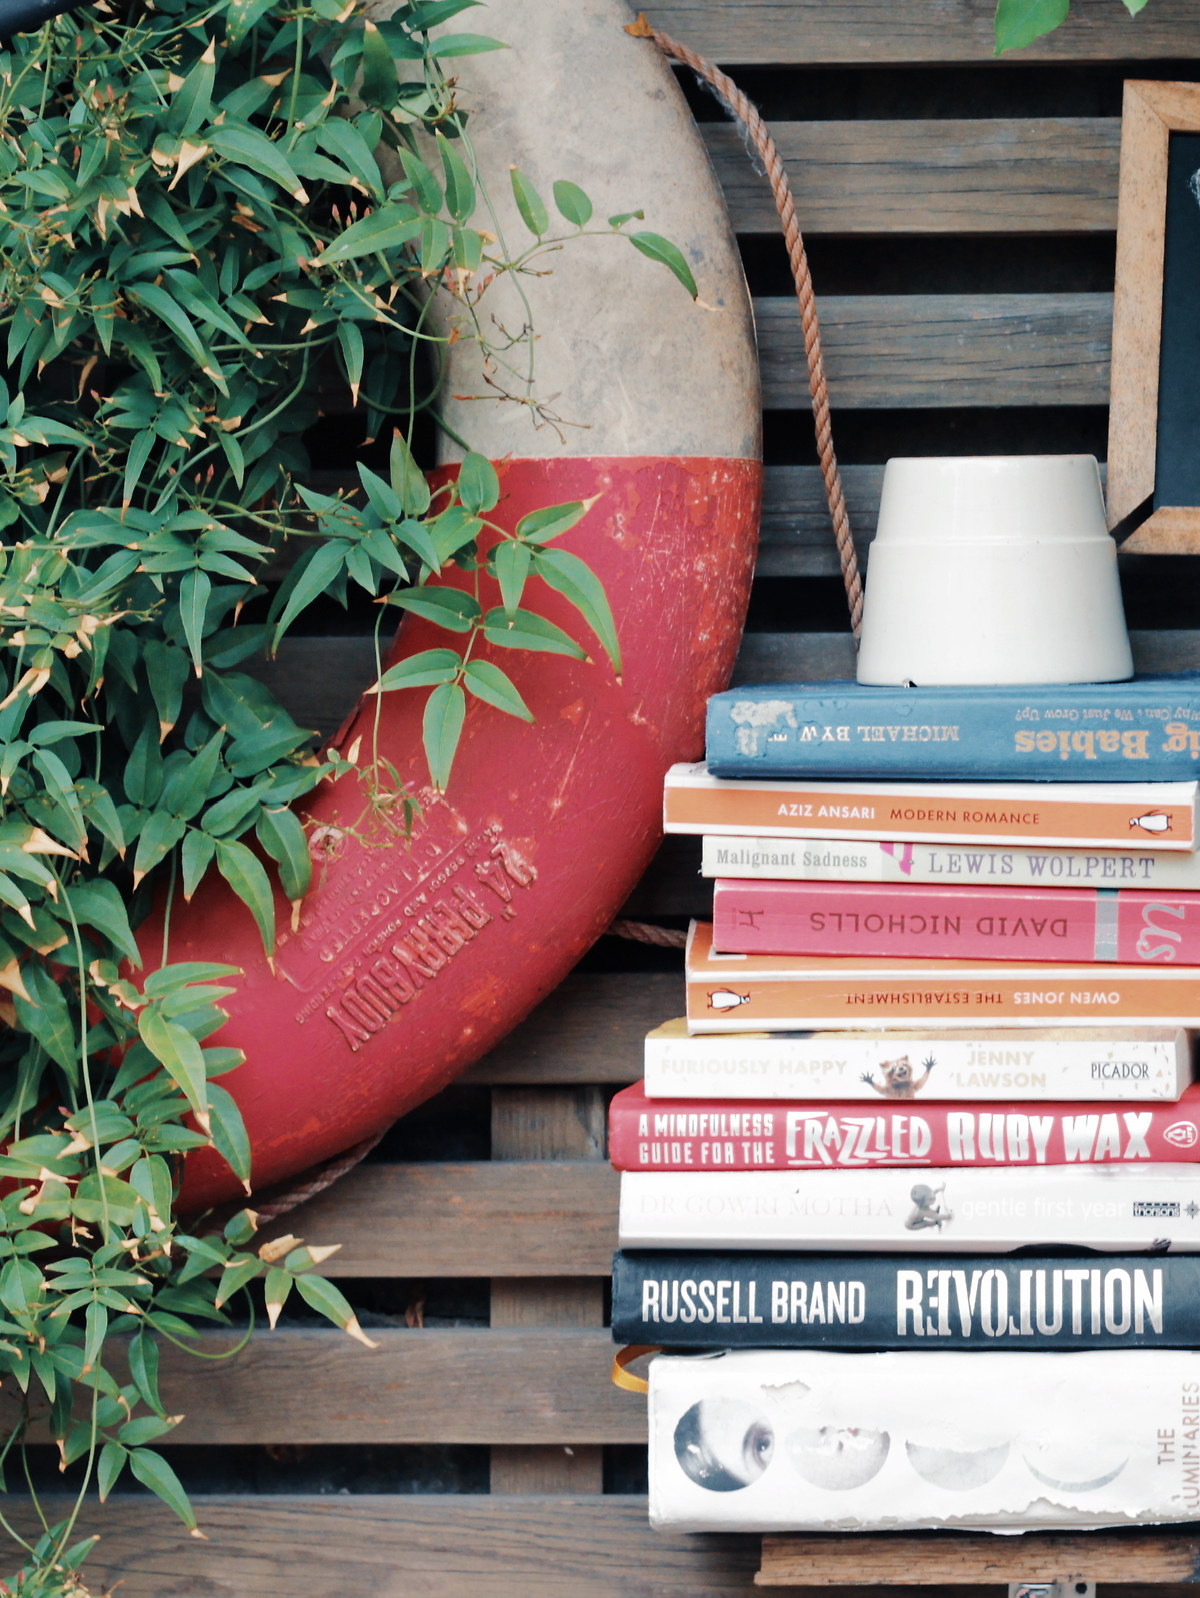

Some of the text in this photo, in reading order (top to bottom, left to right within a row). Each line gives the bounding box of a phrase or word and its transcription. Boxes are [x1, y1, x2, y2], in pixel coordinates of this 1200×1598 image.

[1015, 706, 1040, 722] Up?
[1043, 707, 1079, 721] Grow
[1082, 707, 1111, 721] Just
[1113, 707, 1134, 721] We
[857, 725, 960, 742] MICHAEL
[1014, 729, 1149, 761] Babies
[777, 803, 877, 820] AZIZ ANSARI
[889, 807, 1041, 826] MODERN ROMANCE
[716, 847, 868, 870] Malignant Sadness
[927, 852, 1156, 880] LEWIS WOLPERT
[809, 912, 1067, 938] DAVID NICHOLLS
[846, 992, 1004, 1006] THE ESTABLISHMENT
[1013, 992, 1120, 1006] OWEN JONES
[660, 1058, 848, 1076] FURIOUSLY HAPPY
[967, 1050, 1035, 1067] JENNY
[957, 1071, 1047, 1088] LAWSON
[1090, 1062, 1149, 1081] PICADOR
[638, 1113, 774, 1137] A MINDFULNESS
[786, 1111, 932, 1165] FRAZZLED
[946, 1111, 1153, 1164] RUBY WAX
[639, 1141, 775, 1165] GUIDE FOR THE
[789, 1197, 894, 1217] MOTHA
[961, 1195, 1128, 1221] gentle first year
[1134, 1204, 1180, 1217] thorsons
[641, 1280, 867, 1325] RUSSELL BRAND
[896, 1267, 1163, 1338] REVOLUTION
[1156, 1428, 1176, 1466] THE
